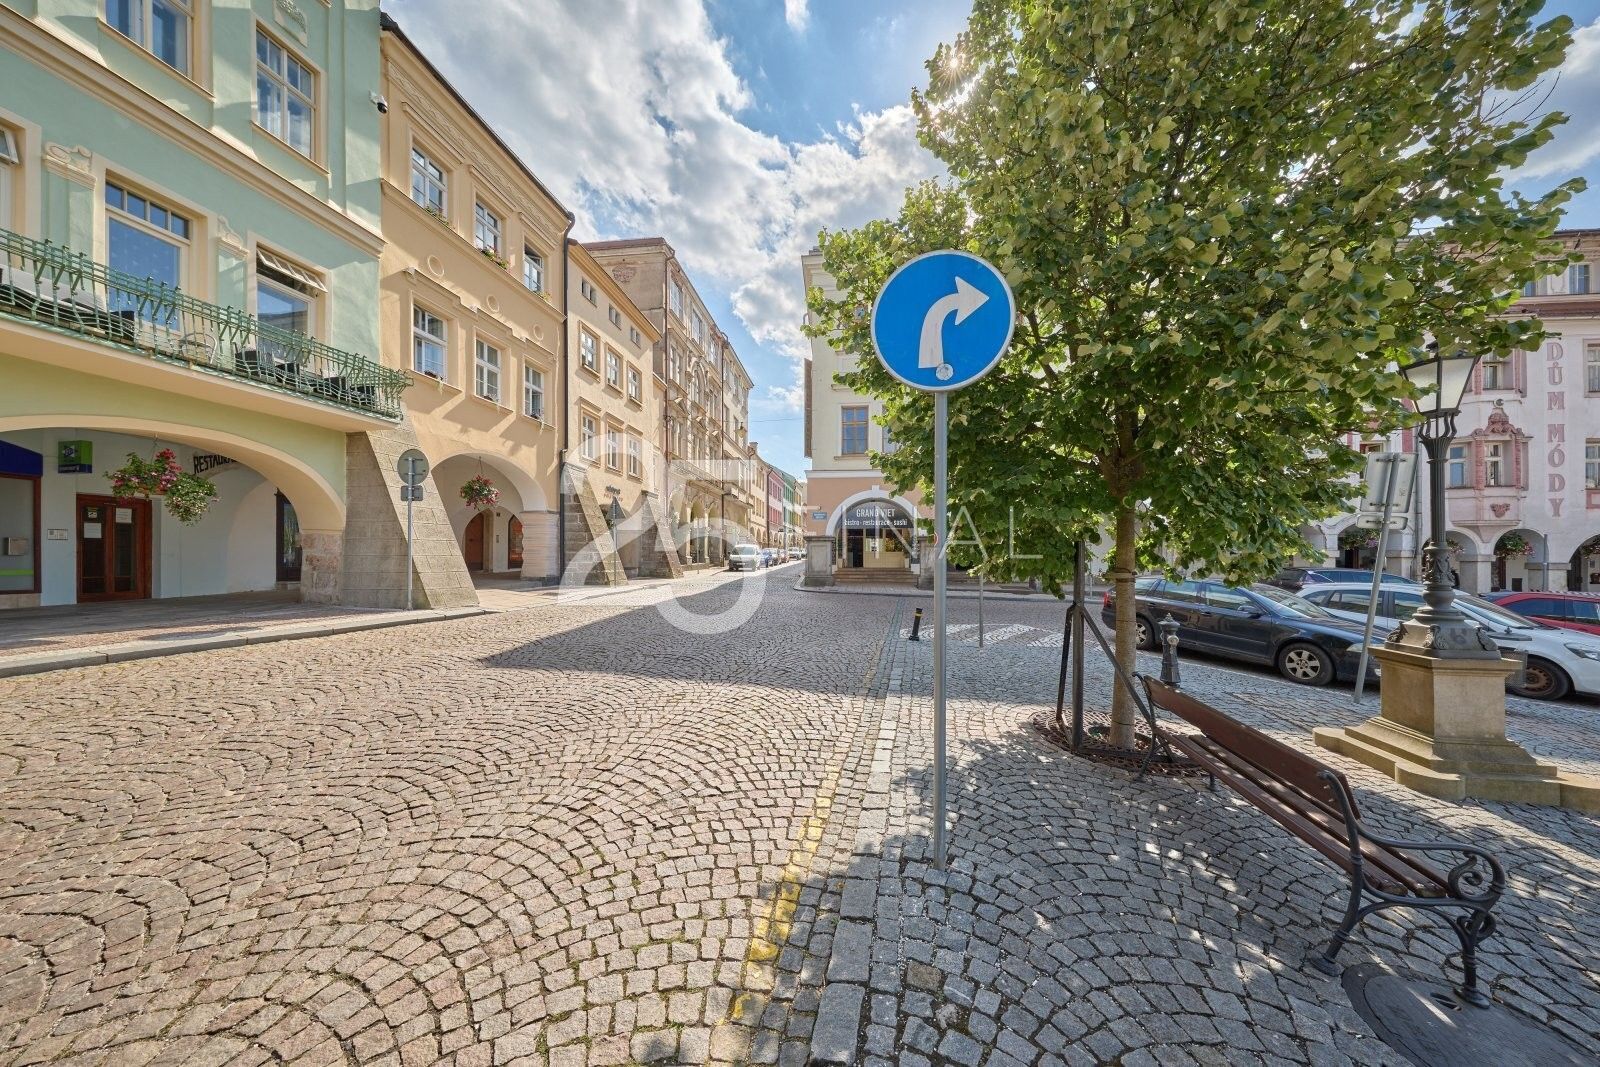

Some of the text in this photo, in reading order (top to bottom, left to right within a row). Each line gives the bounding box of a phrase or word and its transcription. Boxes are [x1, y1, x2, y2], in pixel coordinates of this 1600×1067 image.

[1546, 341, 1566, 518] DŮM MÓDY
[856, 509, 896, 517] GRAND VIET
